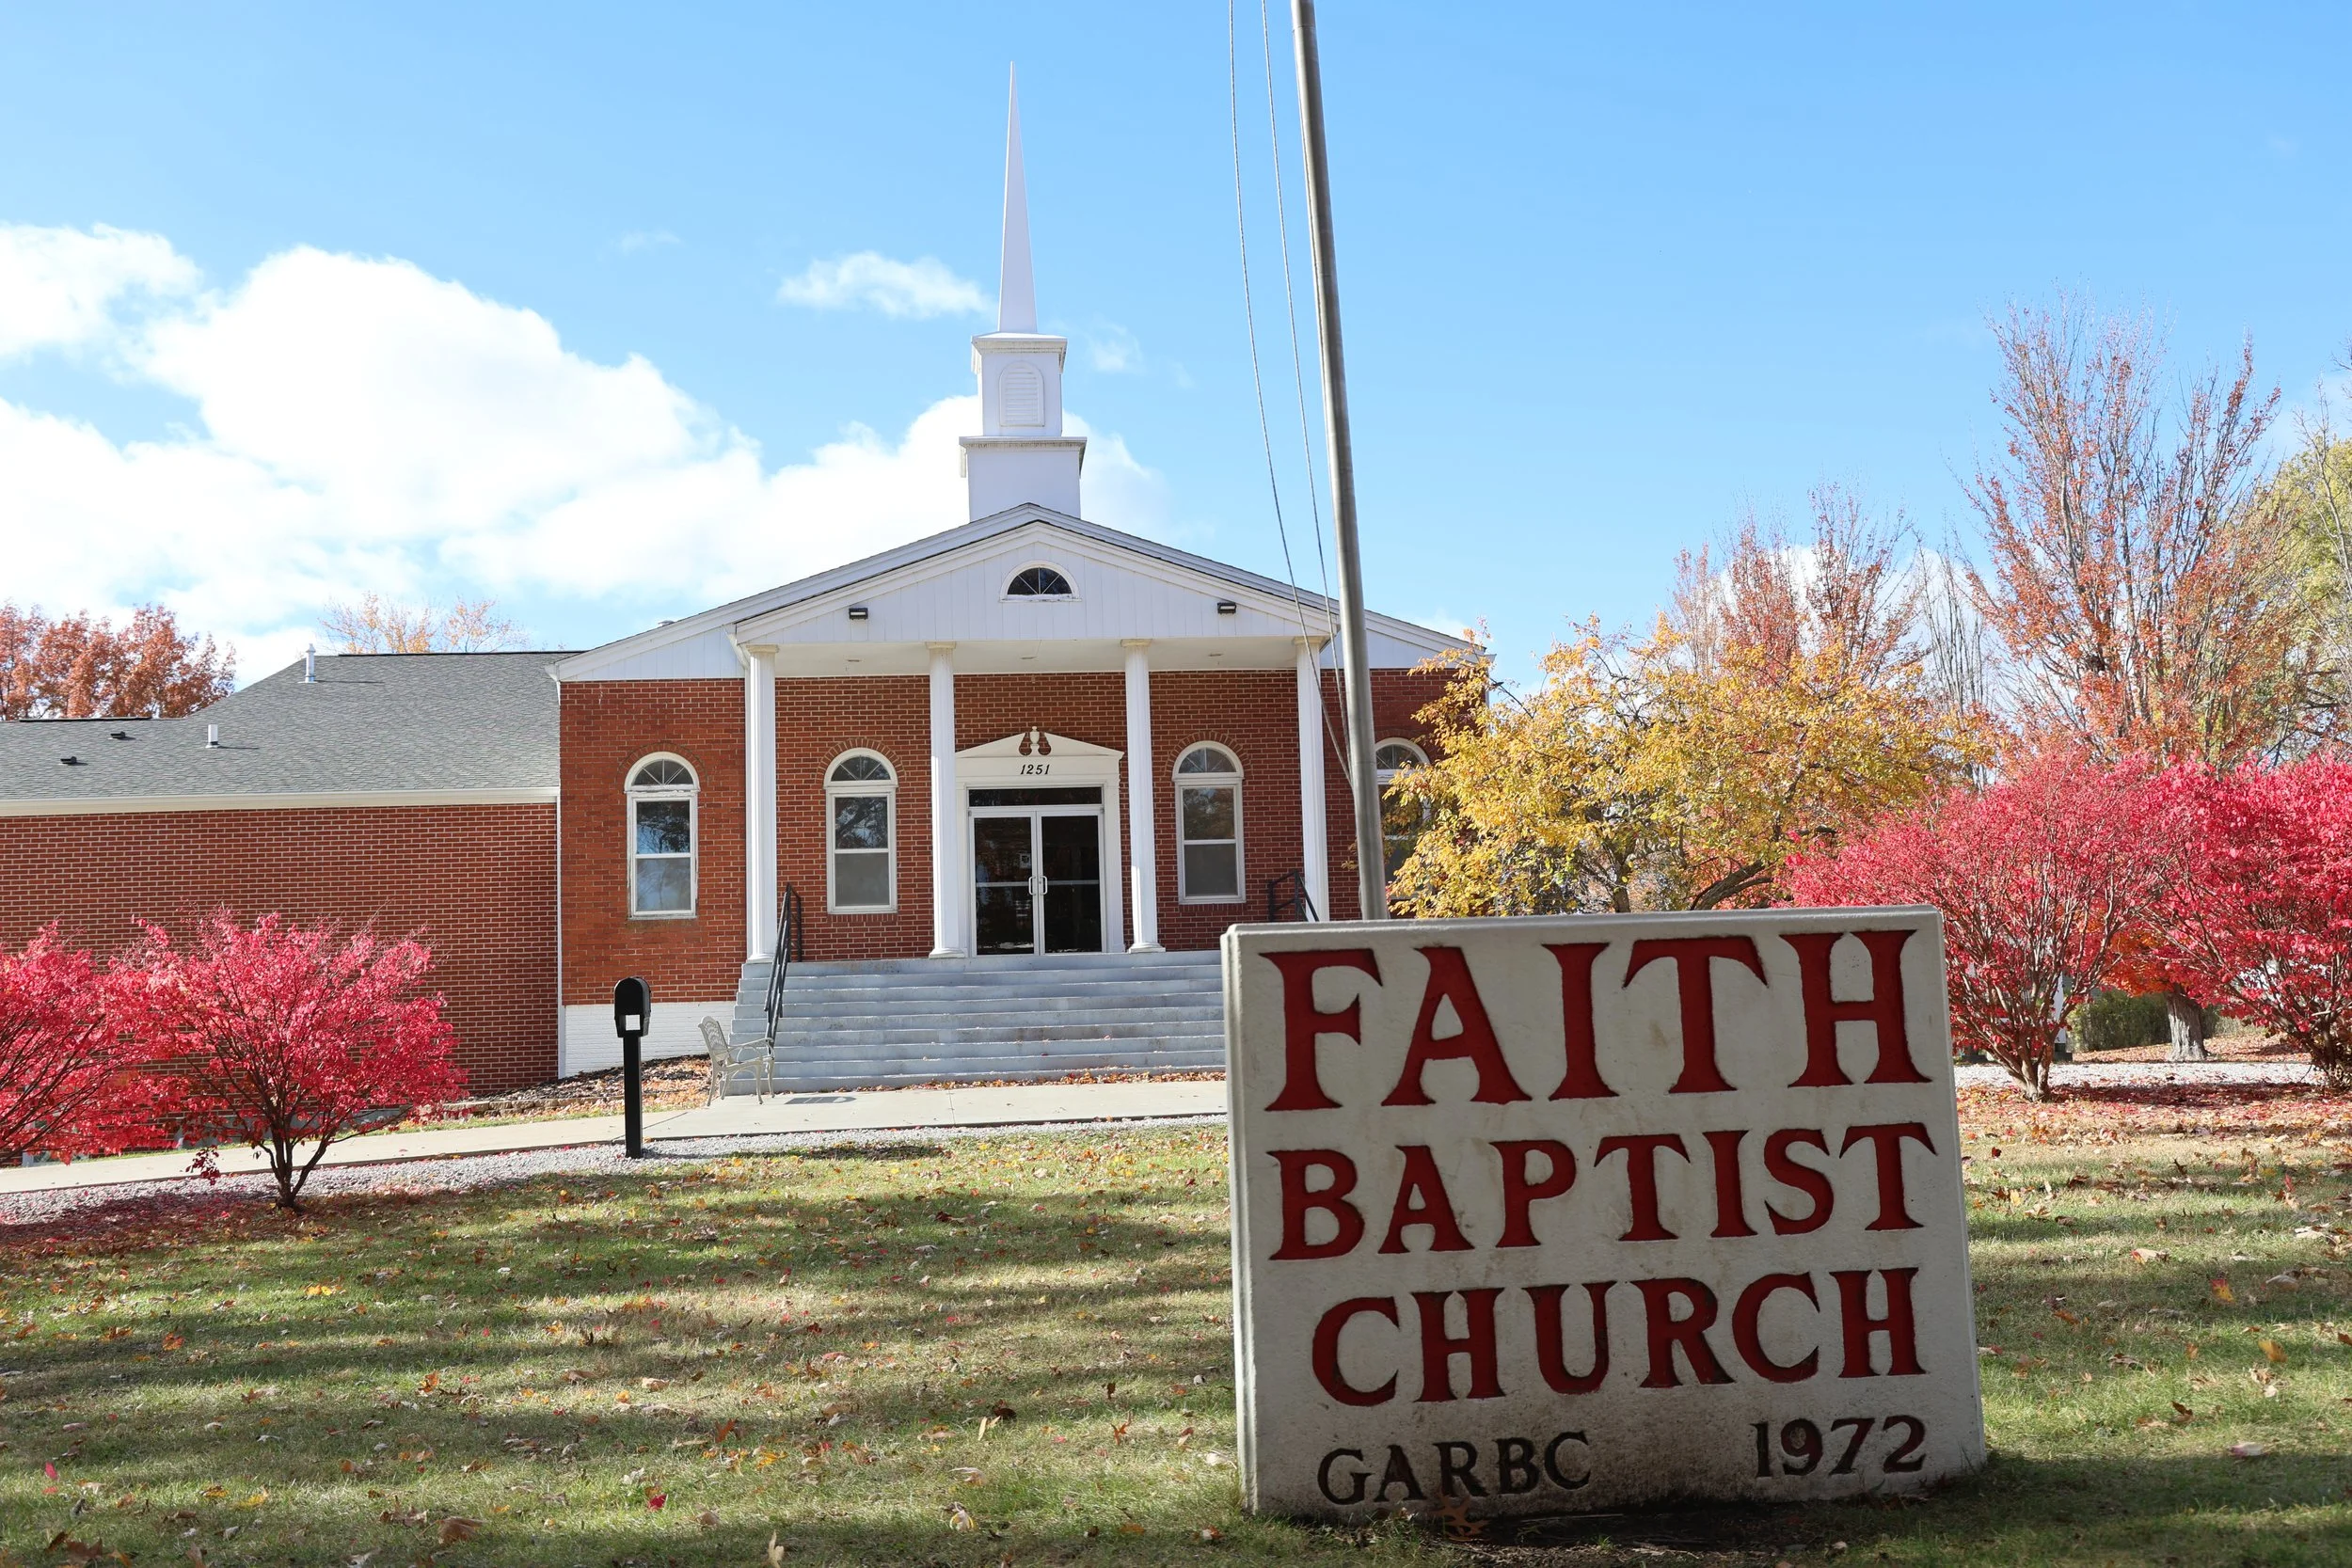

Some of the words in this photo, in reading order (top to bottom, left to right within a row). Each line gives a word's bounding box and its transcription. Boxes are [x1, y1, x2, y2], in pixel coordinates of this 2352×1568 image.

[1020, 764, 1050, 775] 1251
[1260, 929, 1931, 1112] FAITH
[1267, 1122, 1937, 1260] BAPTIST
[1311, 1268, 1927, 1406] CHURCH
[1317, 1431, 1592, 1504] GARBC
[1750, 1415, 1926, 1478] 1972
